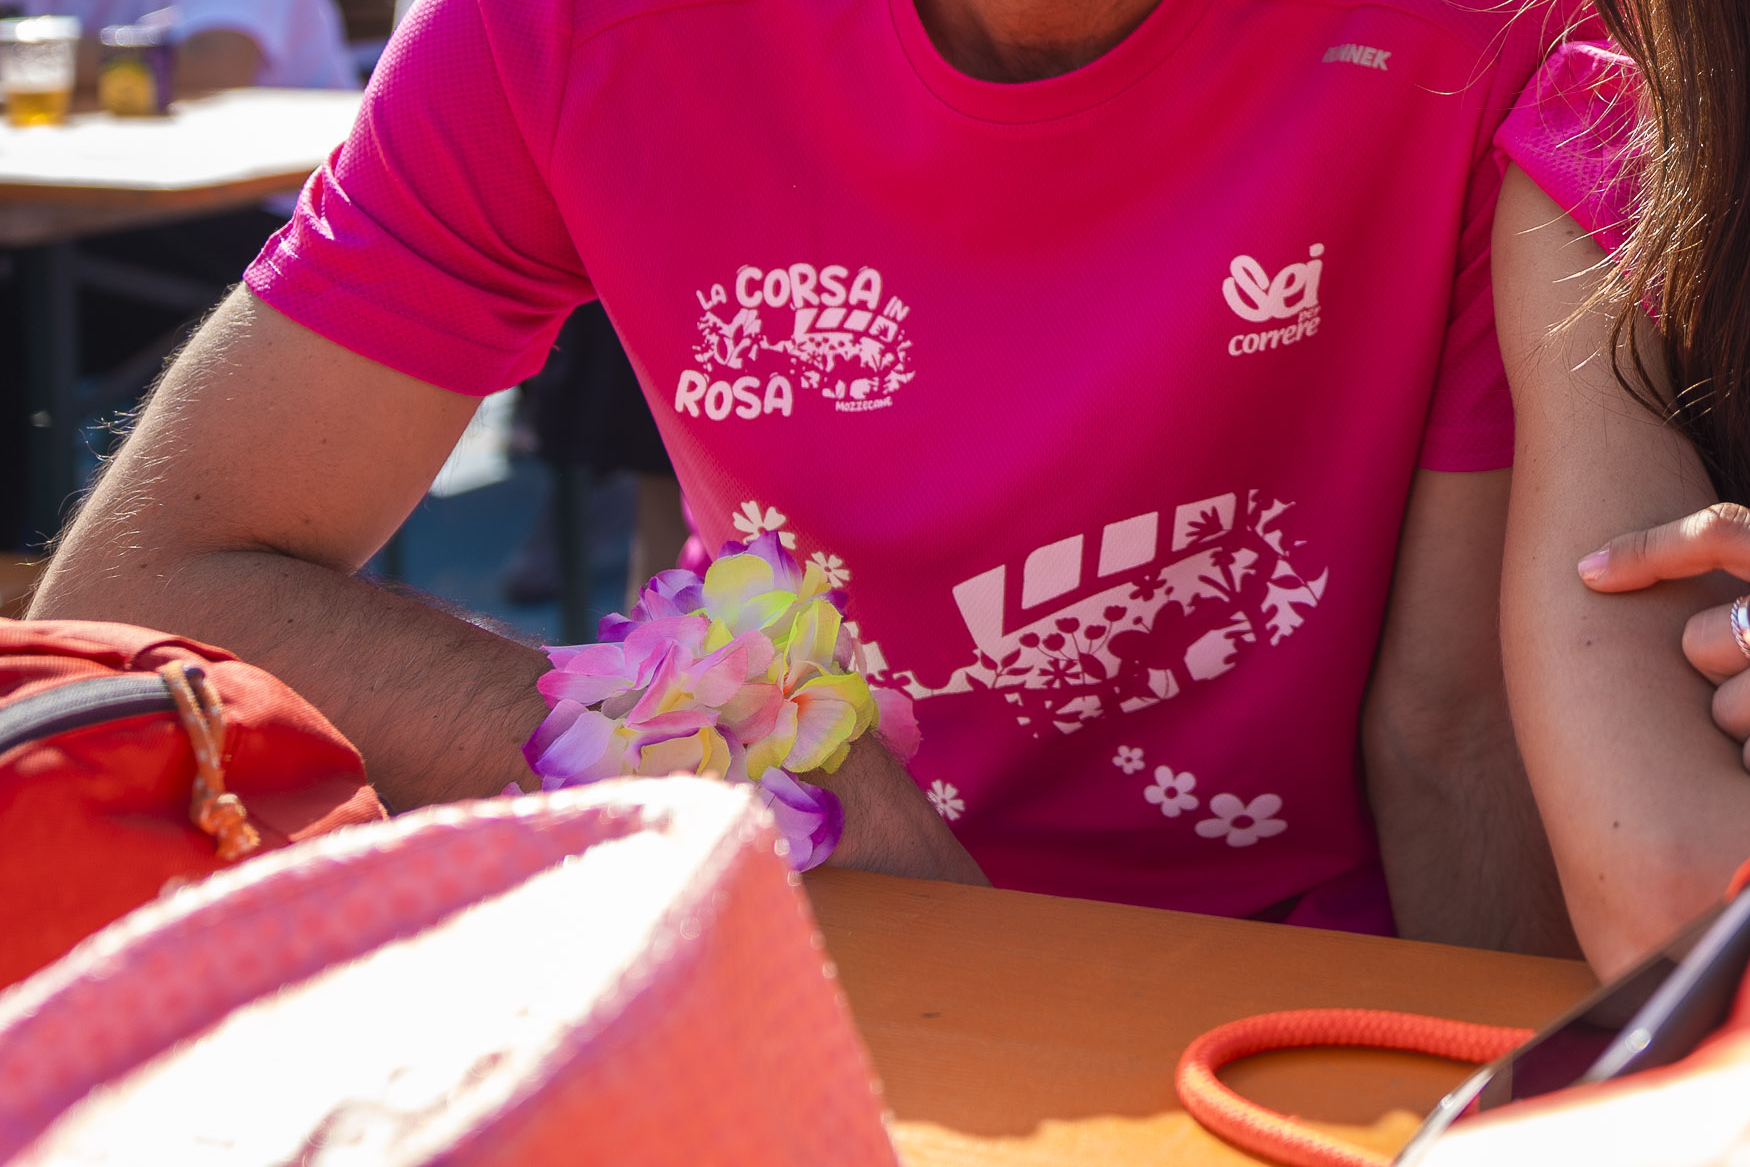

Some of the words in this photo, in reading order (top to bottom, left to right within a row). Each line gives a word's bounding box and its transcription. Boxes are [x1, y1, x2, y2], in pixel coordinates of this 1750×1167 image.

[695, 283, 727, 311] LA
[735, 262, 883, 310] CORSA
[882, 295, 911, 322] IN
[1227, 315, 1322, 356] correre
[674, 368, 793, 422] ROSA
